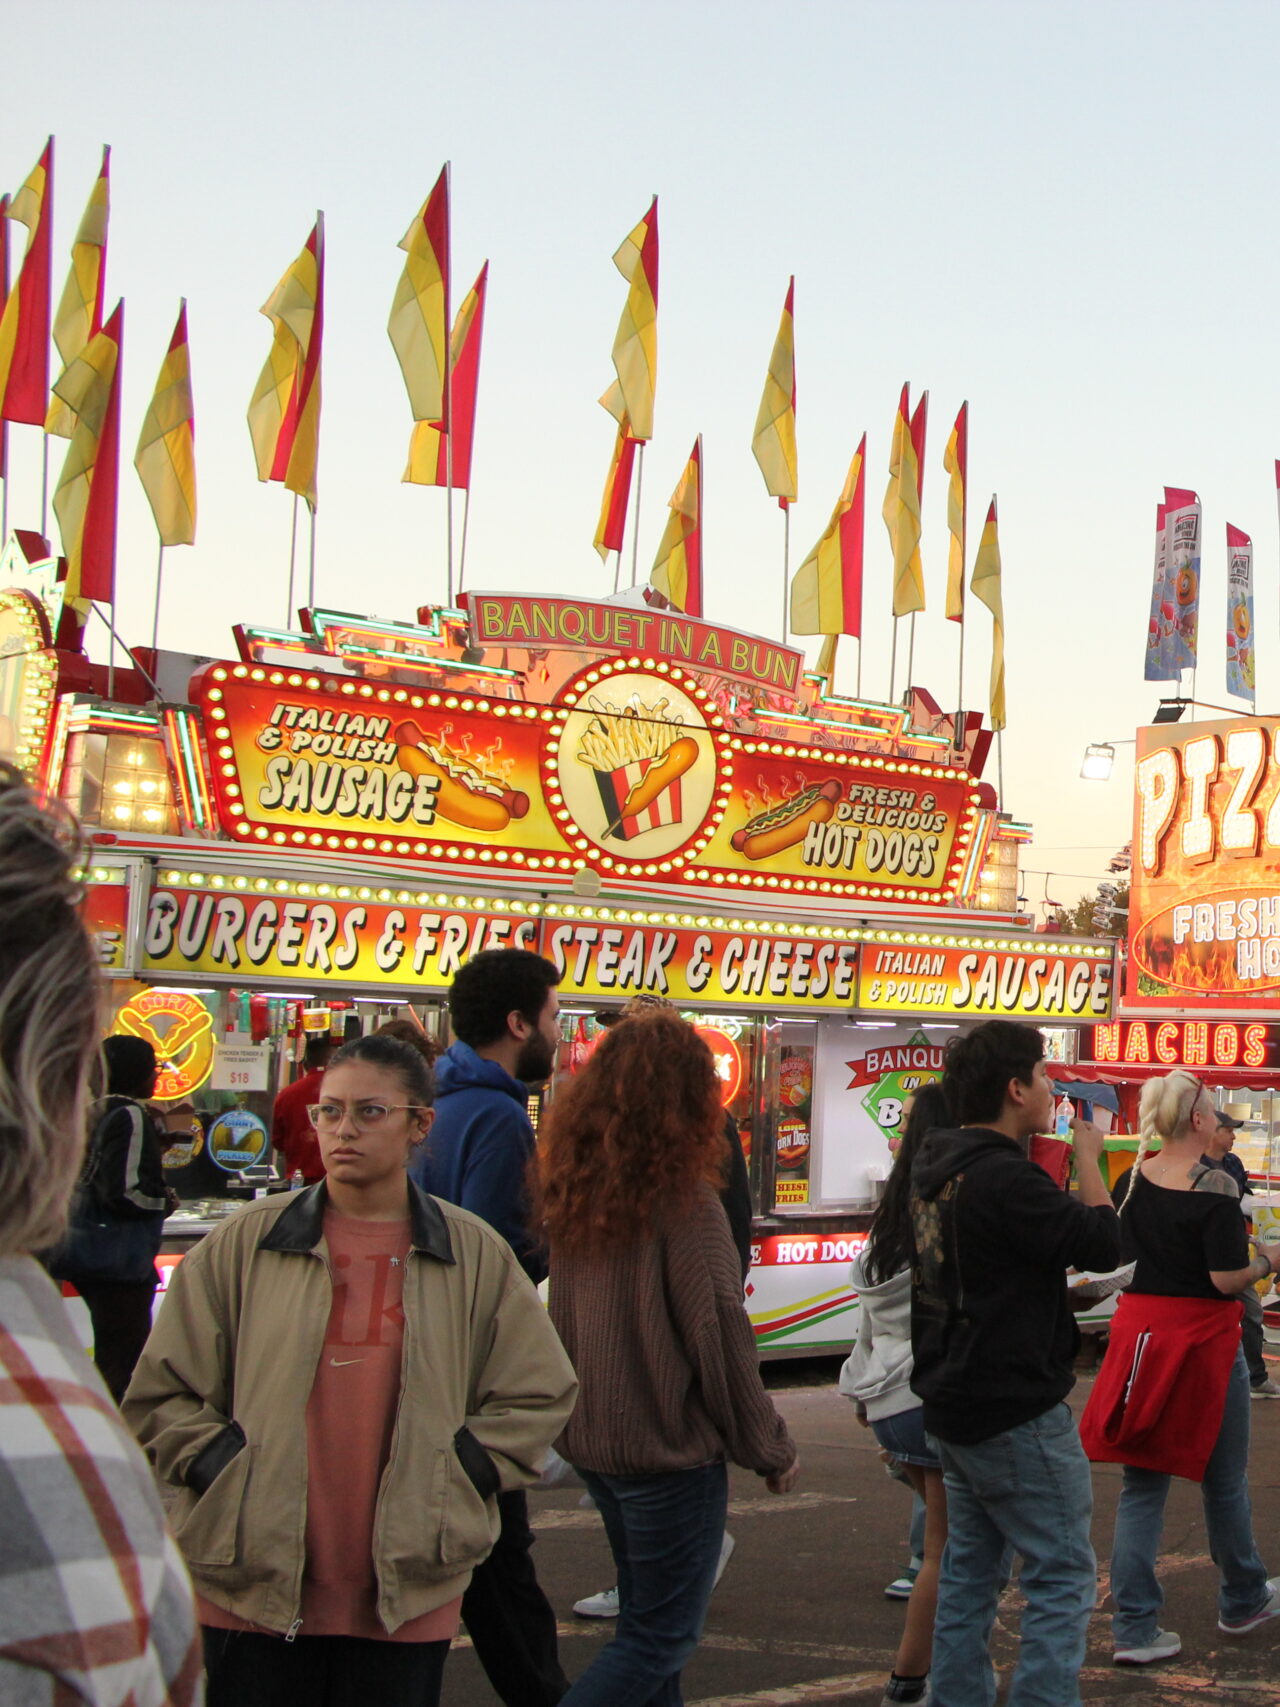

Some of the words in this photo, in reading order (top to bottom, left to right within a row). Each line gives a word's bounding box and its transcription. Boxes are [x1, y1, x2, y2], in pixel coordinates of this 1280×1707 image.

[483, 601, 652, 650] BANQUET
[659, 621, 692, 655] IN
[698, 628, 722, 665] A
[733, 638, 799, 690] BUN
[269, 703, 389, 739] ITALIAN
[258, 728, 281, 750] &
[290, 730, 398, 764] POLISH
[257, 757, 442, 826] SAUSAGE
[847, 783, 917, 810] FRESH
[921, 793, 936, 811] &
[836, 802, 948, 834] DELICIOUS
[802, 820, 860, 868] HOT
[865, 828, 940, 877] DOGS
[144, 890, 367, 974] BURGERS
[376, 911, 406, 971] &
[411, 911, 537, 976] FRIES
[551, 924, 676, 993] STEAK
[687, 942, 713, 990] &
[719, 938, 857, 1000] CHEESE
[874, 949, 946, 977] ITALIAN
[868, 980, 885, 1001] &
[885, 980, 948, 1006] POLISH
[952, 953, 1111, 1015] SAUSAGE
[139, 993, 198, 1016] CORN
[1094, 1022, 1267, 1067] NACHOS
[866, 1046, 943, 1074] BANQU
[153, 1072, 193, 1094] OGS
[229, 1071, 250, 1085] $18
[903, 1077, 921, 1090] IN
[777, 1133, 793, 1150] ORN
[793, 1129, 810, 1147] DOGS
[778, 1123, 806, 1132] LONG
[776, 1183, 808, 1192] HEESE
[776, 1193, 804, 1202] FRIES
[776, 1241, 819, 1264] HOT
